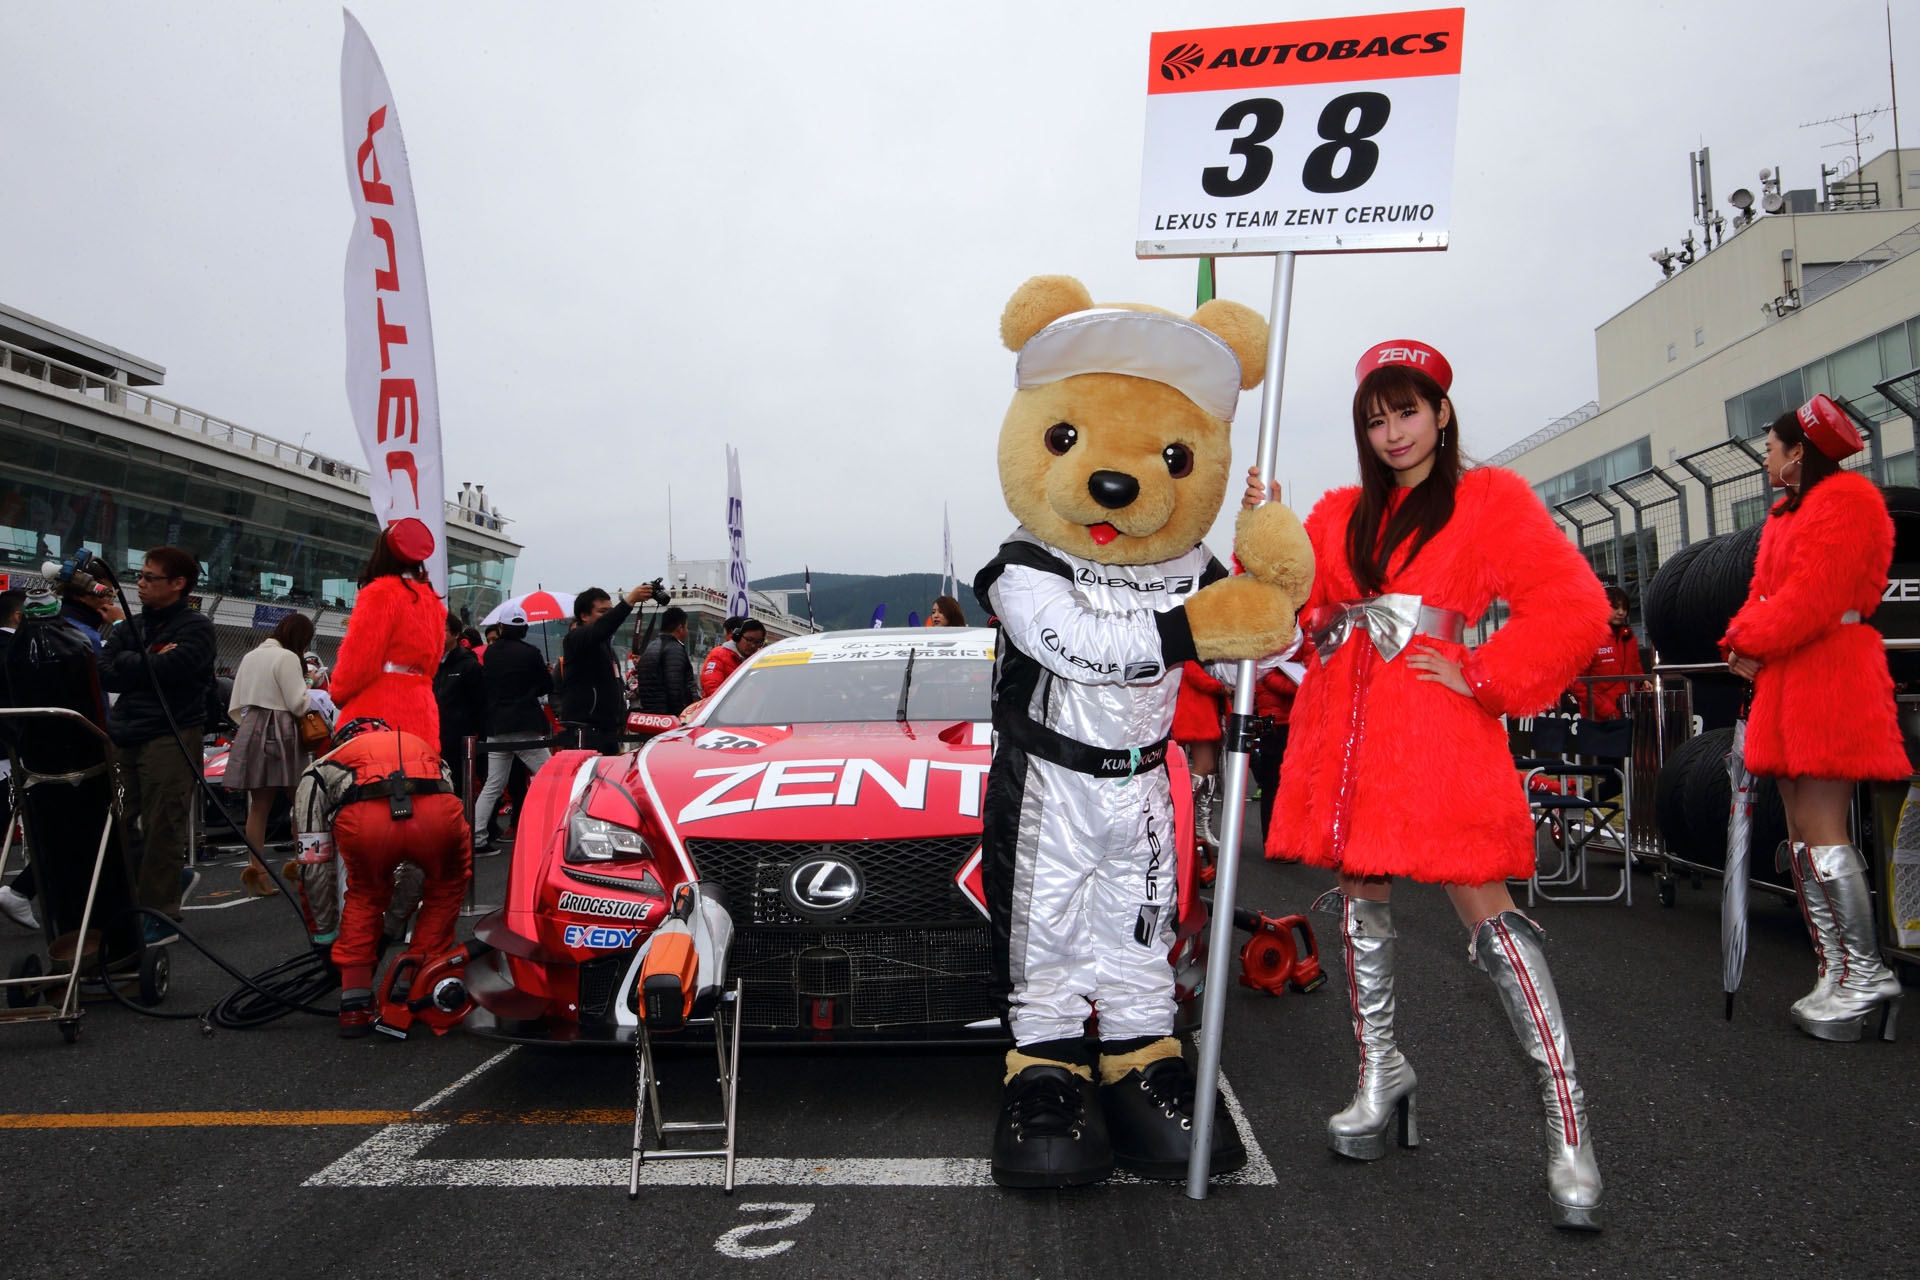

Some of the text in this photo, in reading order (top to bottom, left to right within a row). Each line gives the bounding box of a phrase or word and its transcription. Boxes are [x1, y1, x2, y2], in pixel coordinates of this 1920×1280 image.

[1207, 31, 1450, 70] AUTOBACS
[1154, 203, 1434, 231] LEXUS TEAM ZENT CERUMO
[1377, 347, 1431, 365] ZENT
[1097, 575, 1165, 592] LEXUS
[1060, 646, 1122, 675] LEXUS
[630, 714, 673, 728] EBBRO
[1101, 747, 1163, 770] KUMKICHI
[677, 758, 991, 824] ZENT
[1145, 815, 1158, 901] LEXUS
[559, 893, 652, 919] BRIDGESTONE
[564, 926, 640, 948] EXEDY
